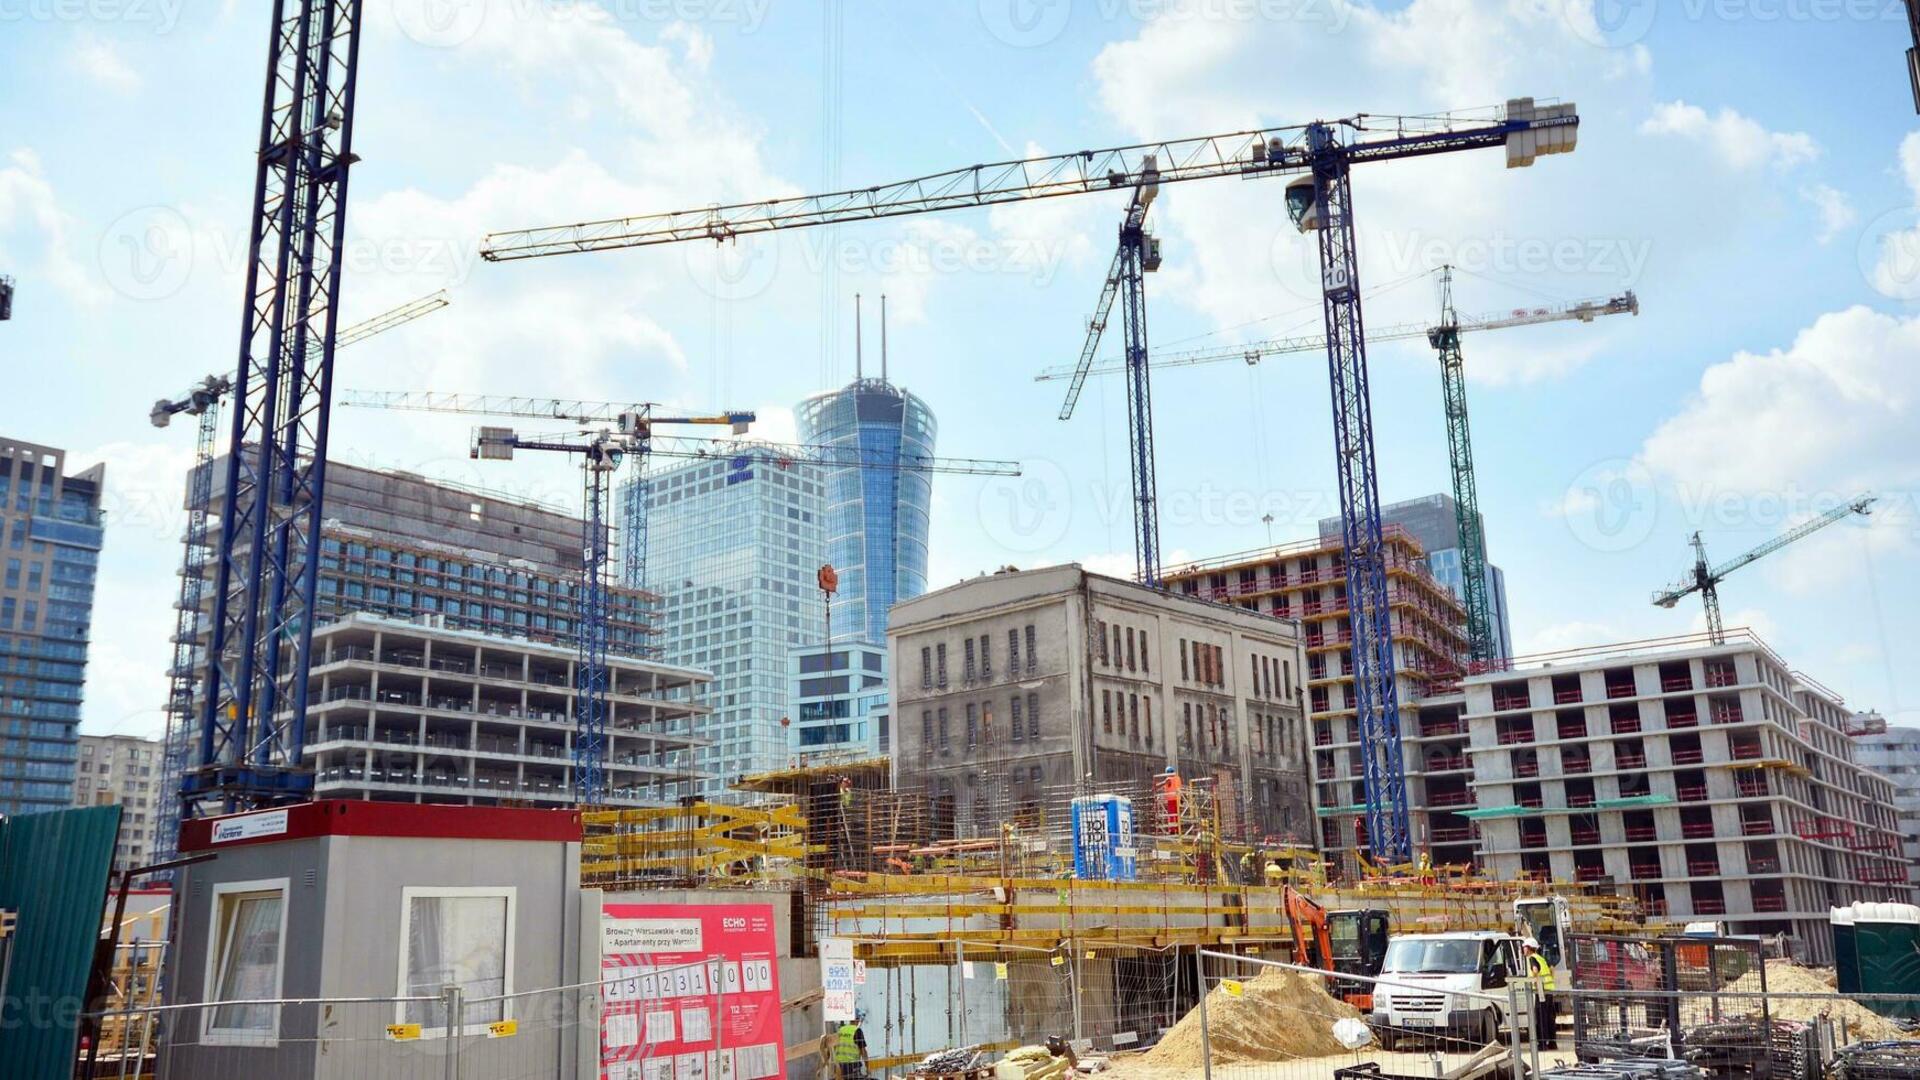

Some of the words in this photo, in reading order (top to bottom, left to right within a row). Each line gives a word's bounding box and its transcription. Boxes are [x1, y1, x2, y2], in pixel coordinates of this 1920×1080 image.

[1326, 269, 1345, 286] 10
[585, 549, 591, 558] 7
[722, 917, 746, 928] ECHO
[680, 928, 693, 936] etap
[730, 1004, 740, 1014] 112
[386, 1027, 404, 1035] TLC
[489, 1025, 504, 1034] TLC
